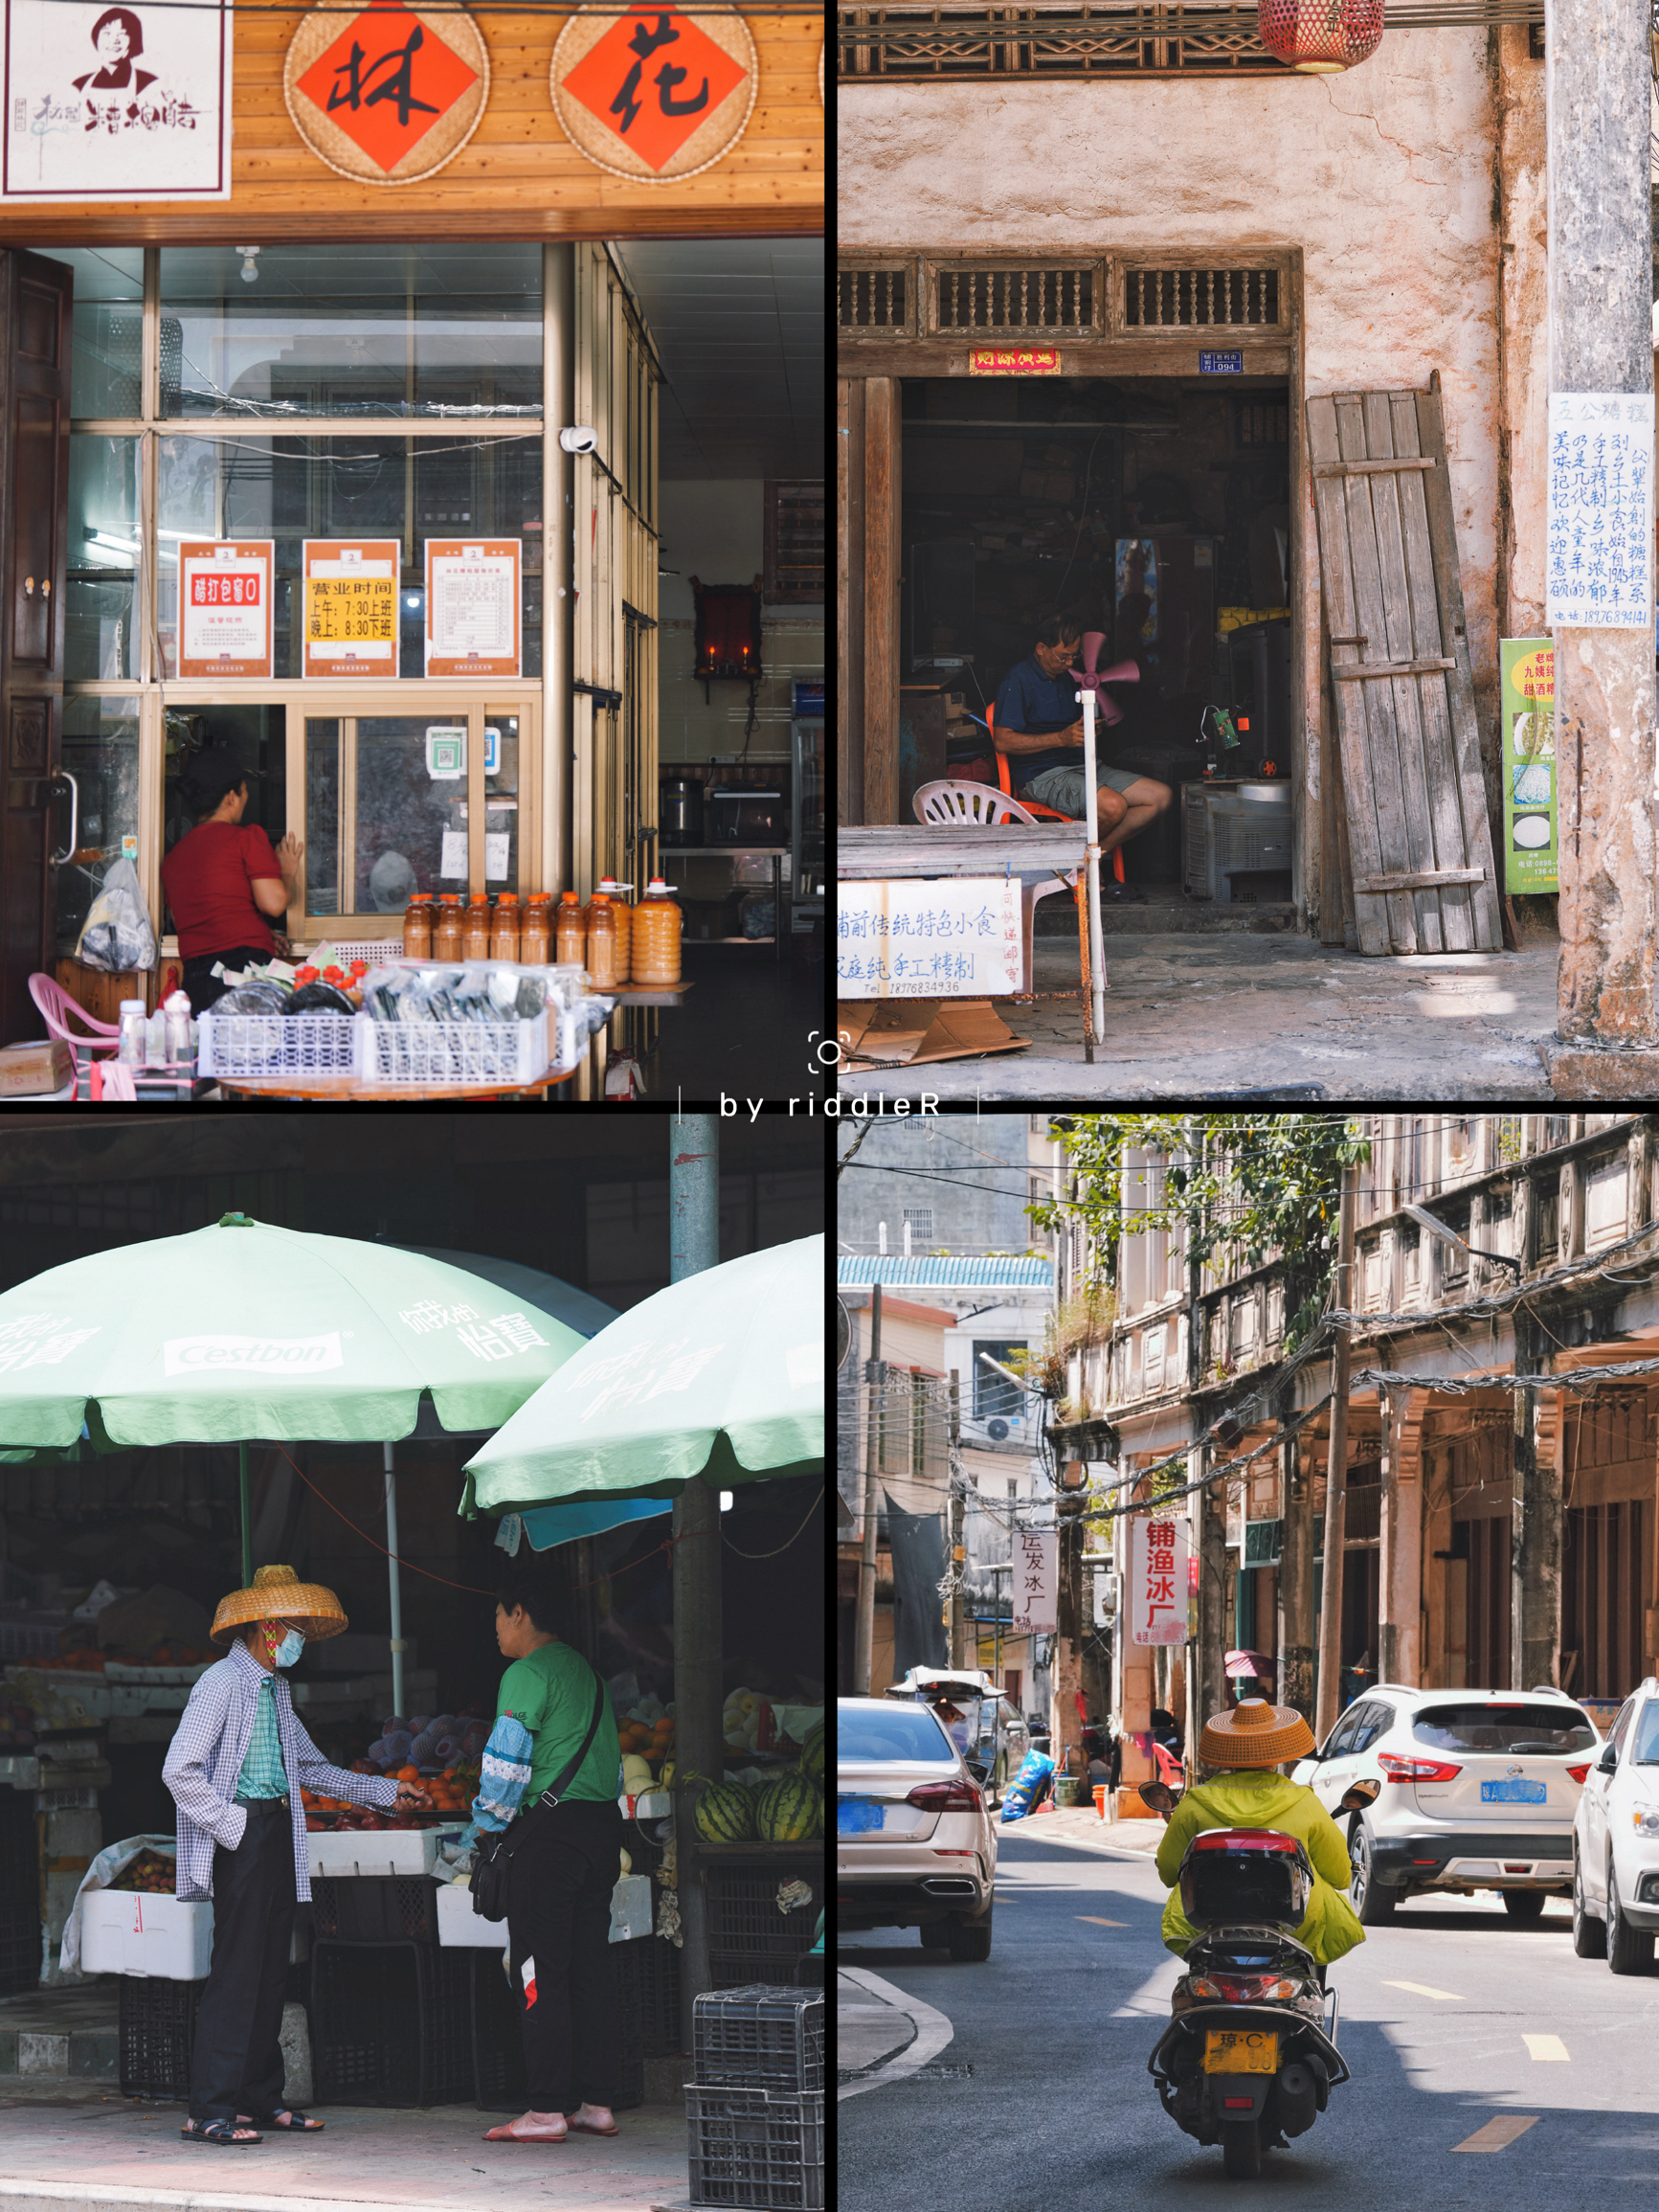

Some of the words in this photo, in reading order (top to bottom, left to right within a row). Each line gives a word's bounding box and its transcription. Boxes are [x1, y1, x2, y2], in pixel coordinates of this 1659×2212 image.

[325, 25, 441, 127] 林
[608, 14, 709, 134] 花
[194, 577, 257, 602] 醋打包窗口
[312, 582, 392, 596] 营业时间
[864, 982, 880, 993] Tel
[889, 982, 959, 994] 18976834936
[398, 1298, 480, 1335] 你我的
[457, 1312, 550, 1362] 怡寶
[1020, 1533, 1045, 1614] 运发冰厂
[1146, 1521, 1176, 1628] 铺渔冰厂
